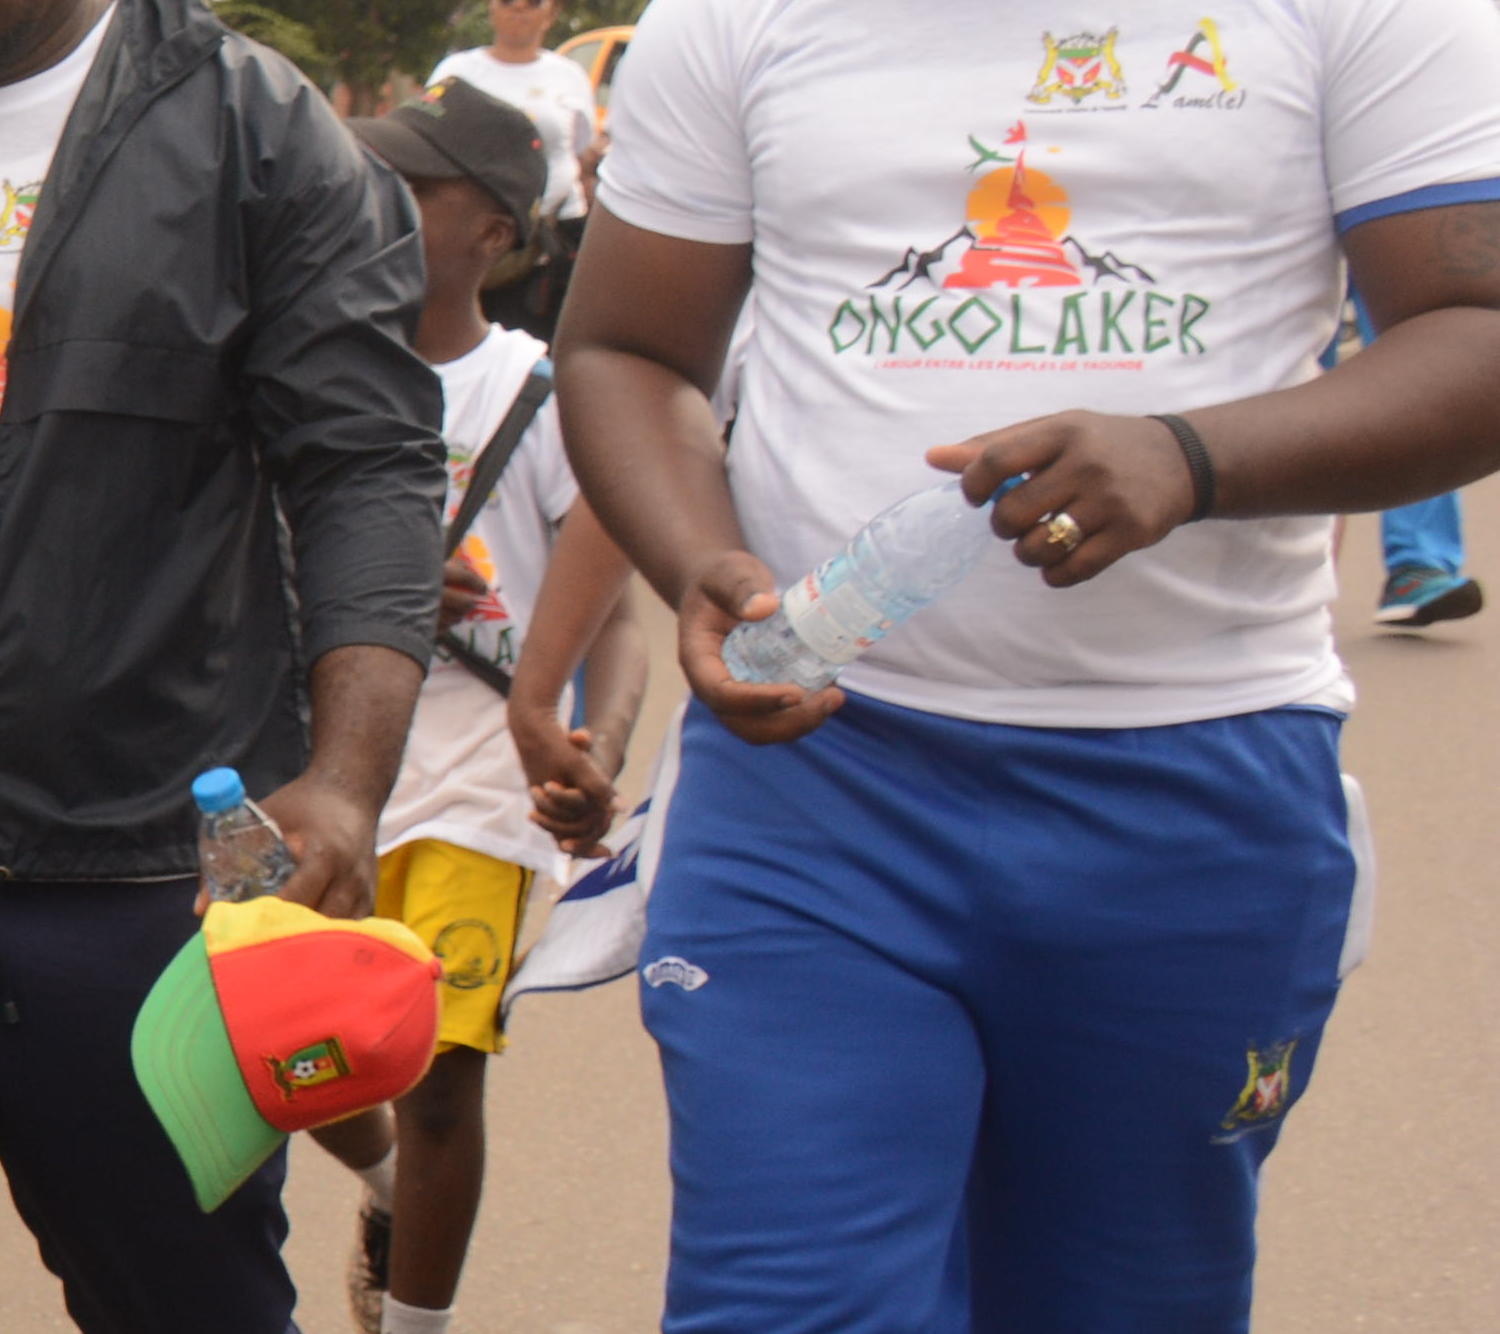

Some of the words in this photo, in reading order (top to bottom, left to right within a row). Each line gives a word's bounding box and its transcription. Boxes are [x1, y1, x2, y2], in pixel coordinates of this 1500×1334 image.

[828, 289, 1211, 356] ONGOLAKER
[925, 360, 965, 371] ENTRE
[968, 361, 993, 371] LES
[997, 361, 1056, 372] PEUPLES
[1060, 362, 1079, 372] DE
